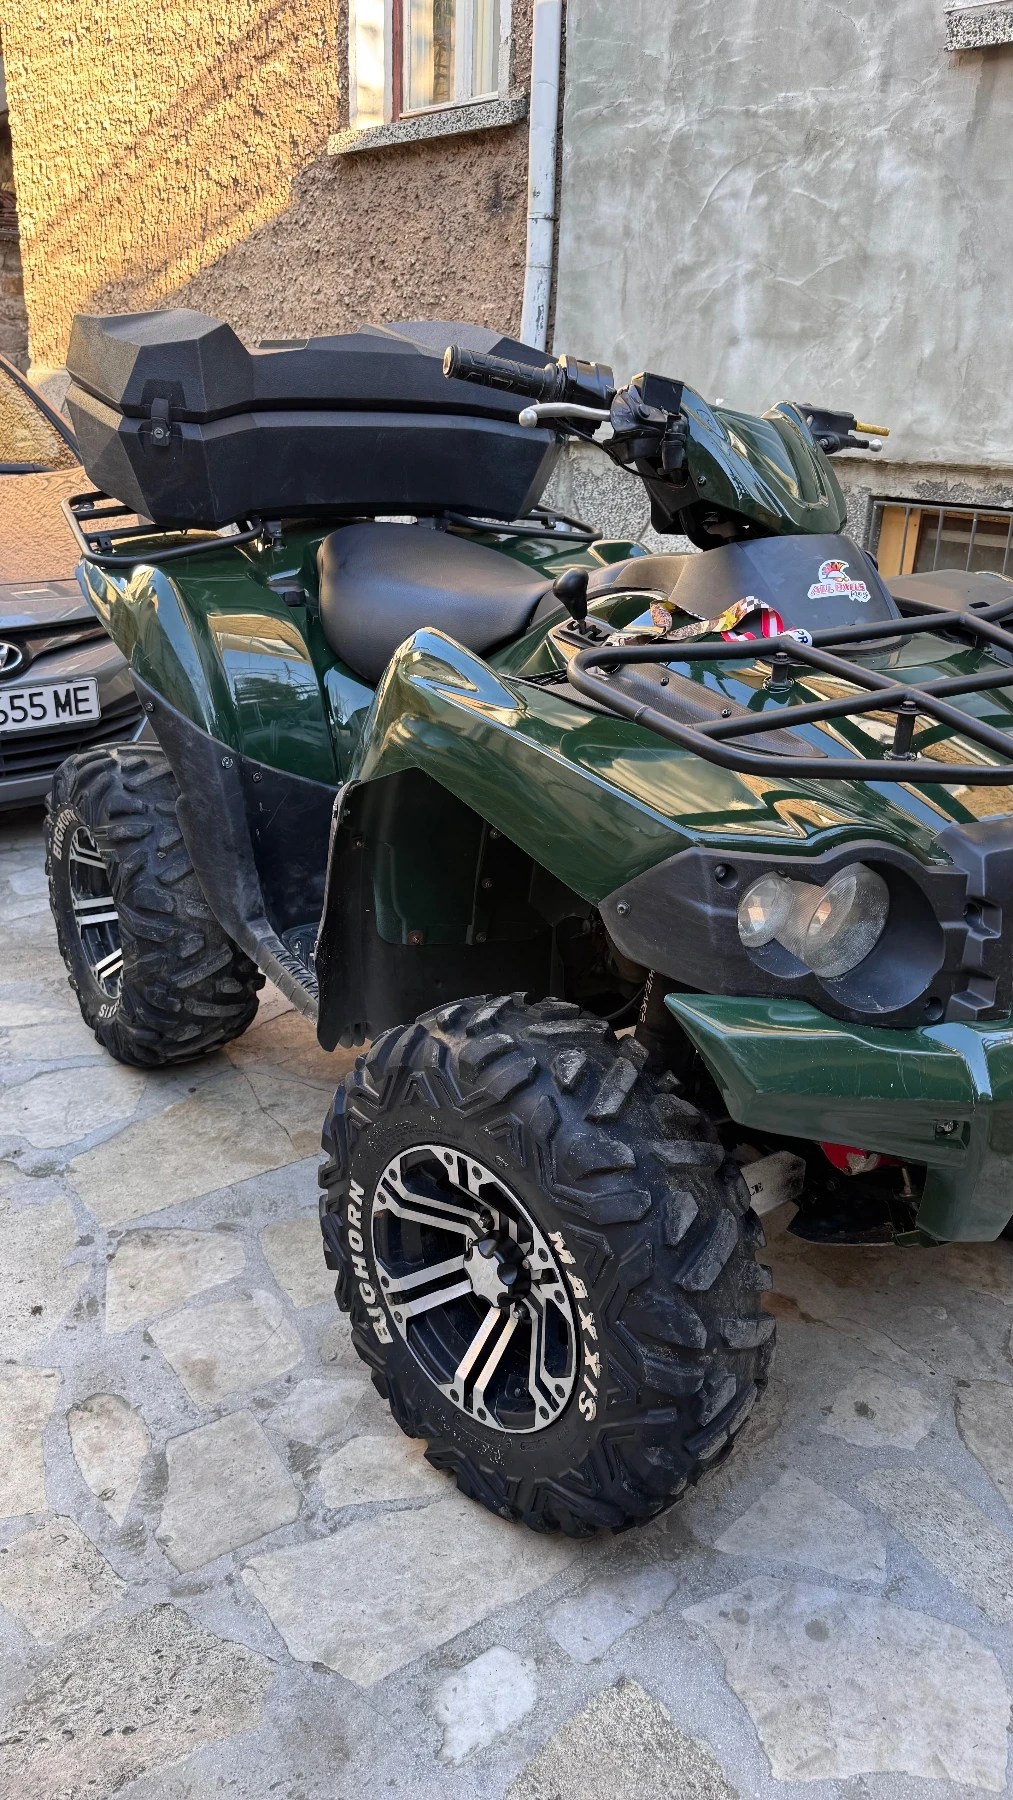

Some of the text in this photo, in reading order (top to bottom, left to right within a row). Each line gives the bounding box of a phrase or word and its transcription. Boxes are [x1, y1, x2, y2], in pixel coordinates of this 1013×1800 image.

[53, 686, 93, 718] ME
[53, 809, 78, 860] BIGHORN
[348, 1179, 394, 1345] BIGHORN
[548, 1231, 603, 1422] MAXXIS
